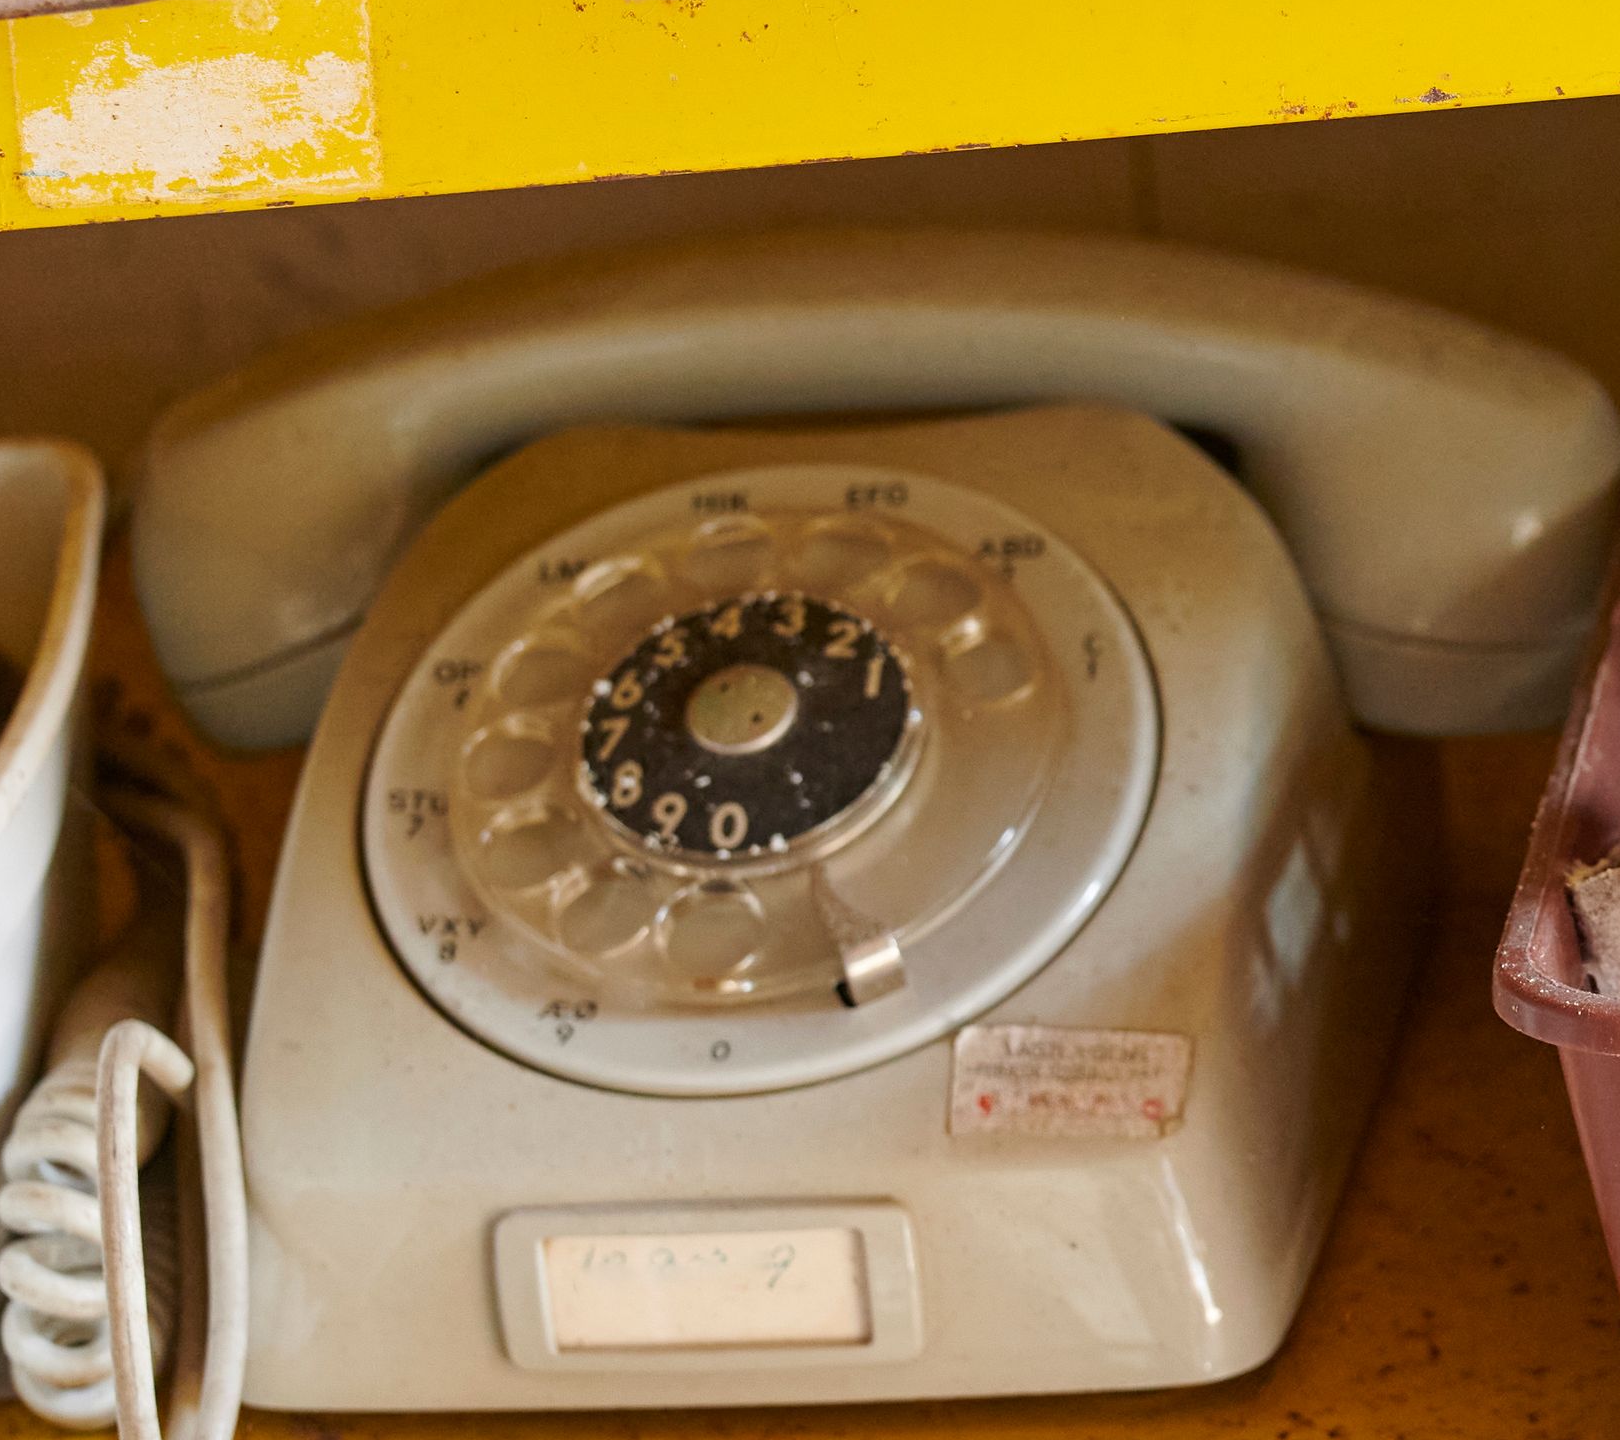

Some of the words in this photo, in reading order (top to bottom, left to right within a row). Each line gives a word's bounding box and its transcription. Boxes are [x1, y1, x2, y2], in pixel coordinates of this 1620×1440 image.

[709, 606, 742, 640] 4
[773, 602, 806, 638] 3
[824, 620, 861, 658] 2
[652, 629, 687, 667] 5
[611, 669, 644, 710] 6
[863, 655, 885, 699] 1
[598, 716, 630, 761] 7
[611, 760, 644, 809] 8
[651, 792, 688, 839] 9
[709, 801, 749, 850] 0
